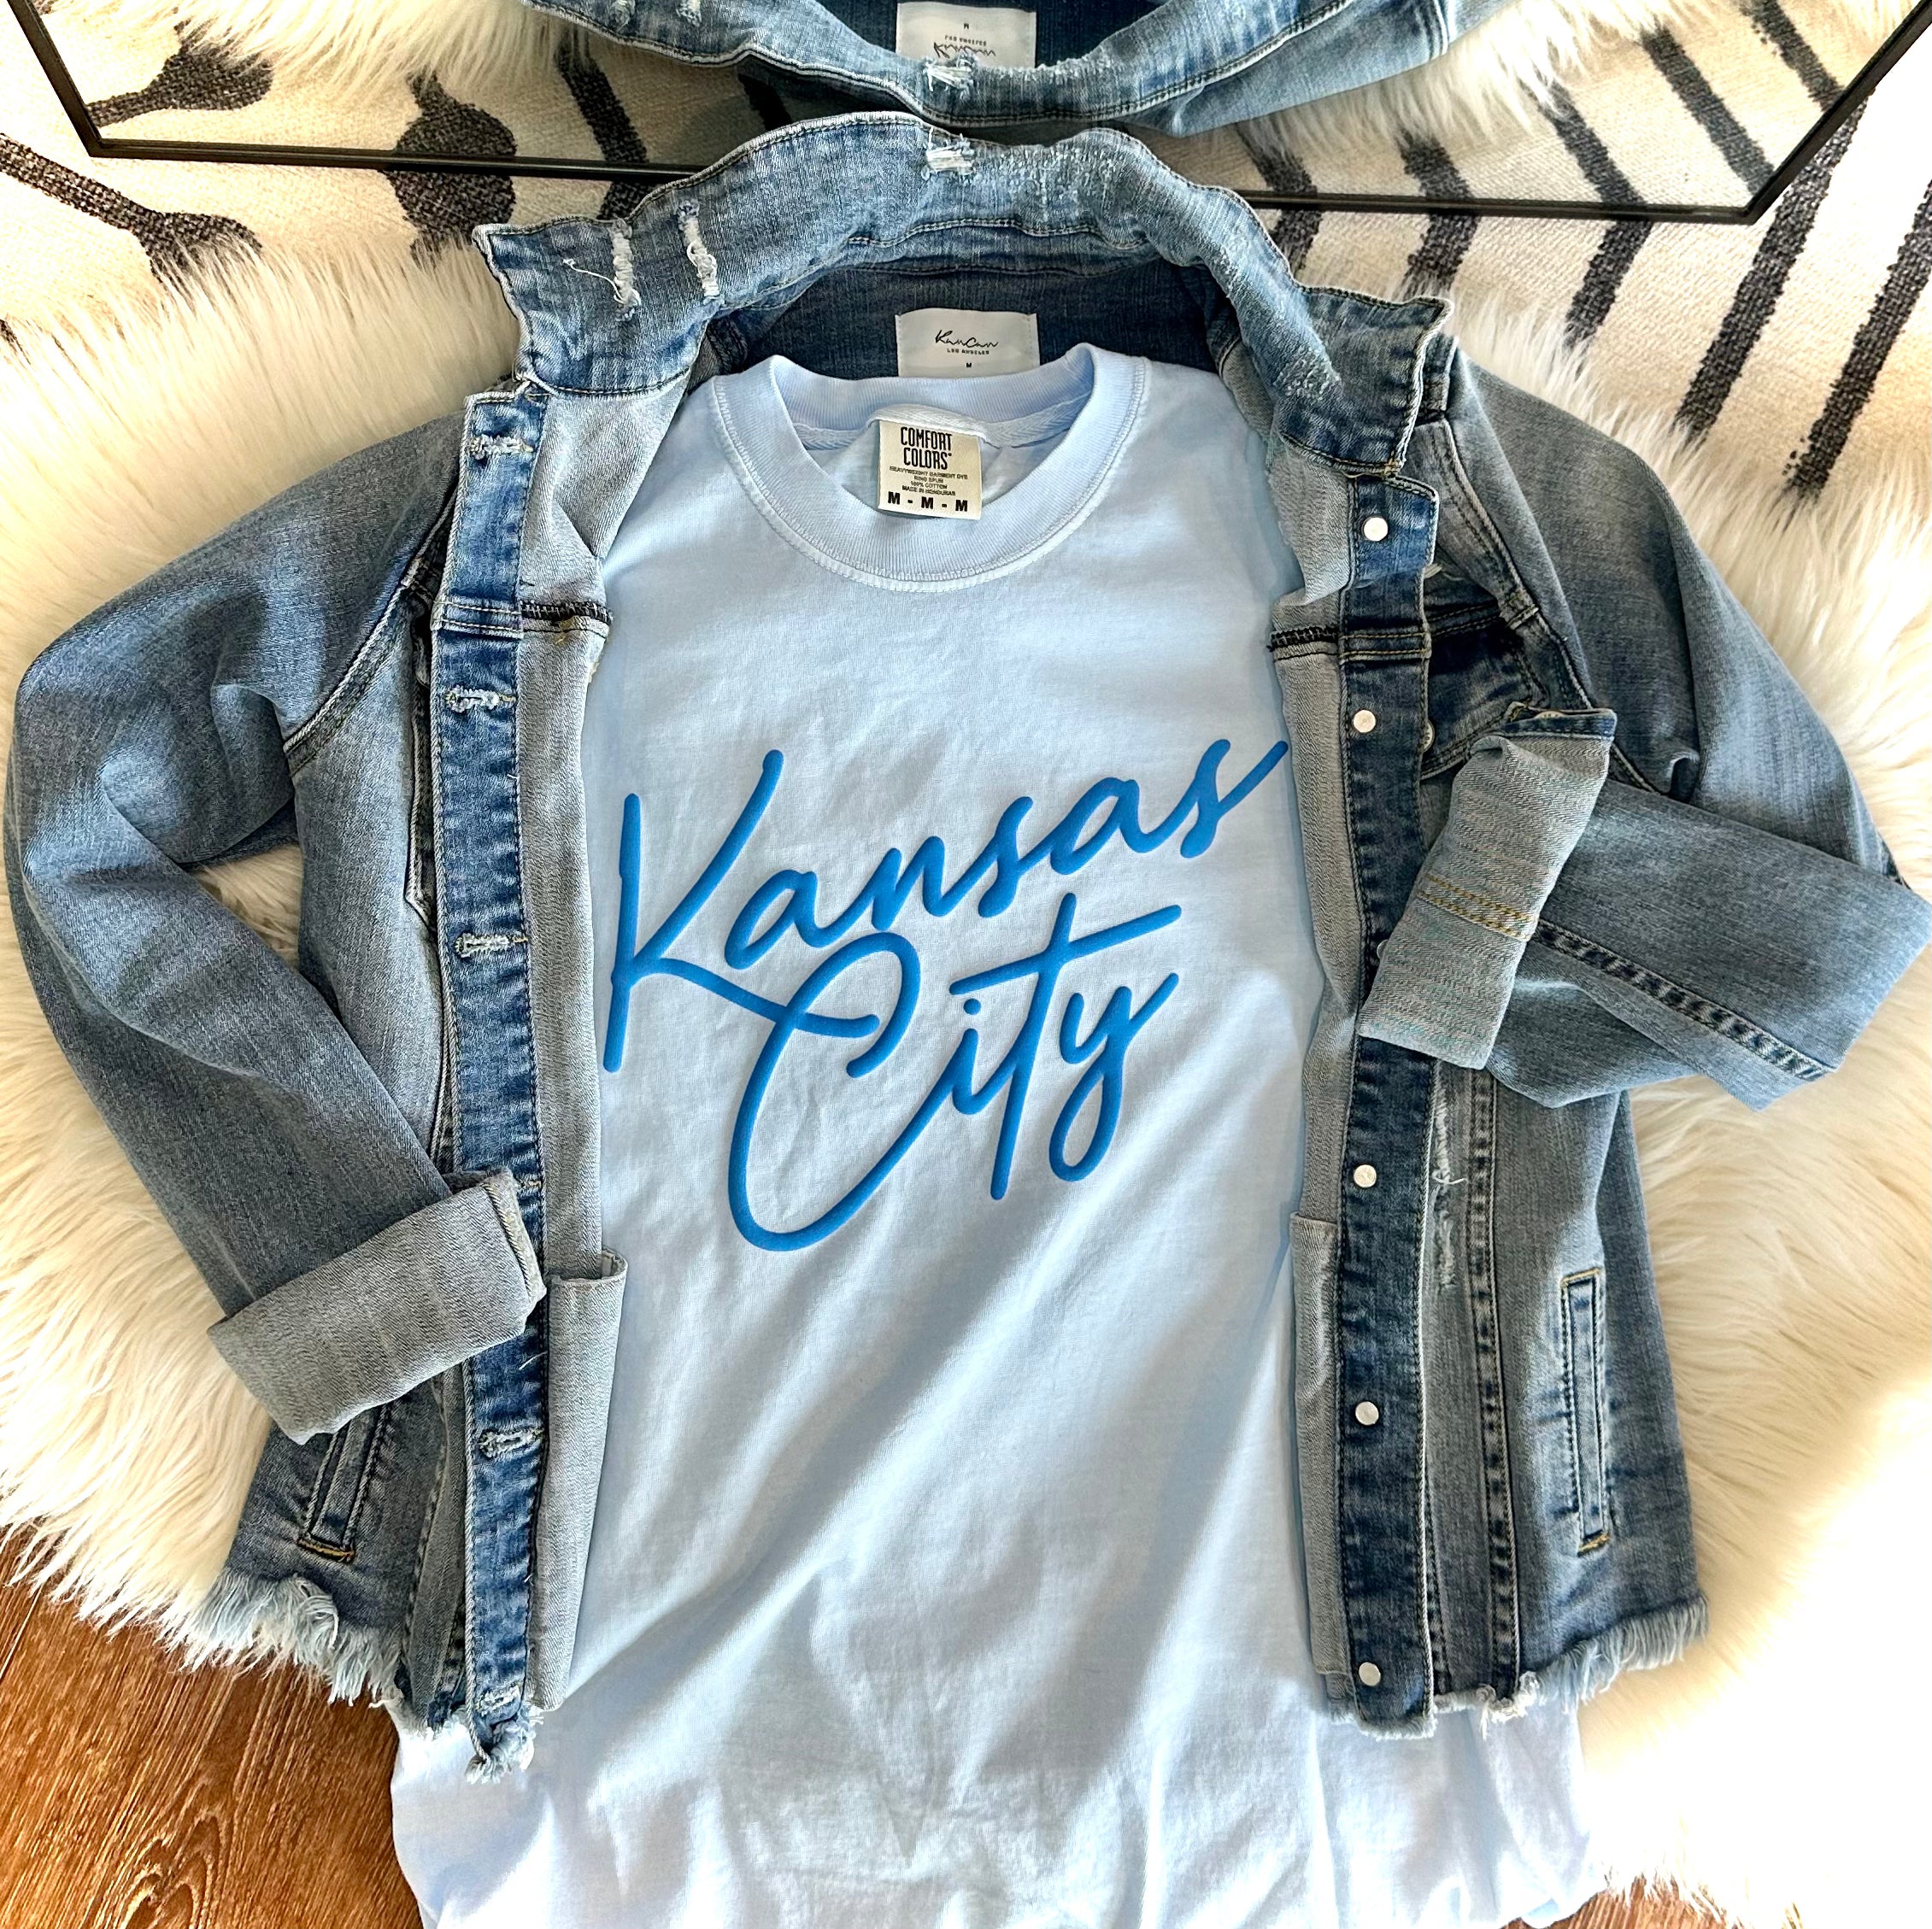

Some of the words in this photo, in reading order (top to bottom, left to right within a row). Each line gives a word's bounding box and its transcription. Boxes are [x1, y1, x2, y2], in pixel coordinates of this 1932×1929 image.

[888, 491, 901, 505] M
[921, 496, 933, 509] M
[955, 500, 967, 512] M
[901, 426, 953, 451] COMFORT
[602, 739, 1288, 1073] Kansas
[728, 893, 1183, 1252] City
